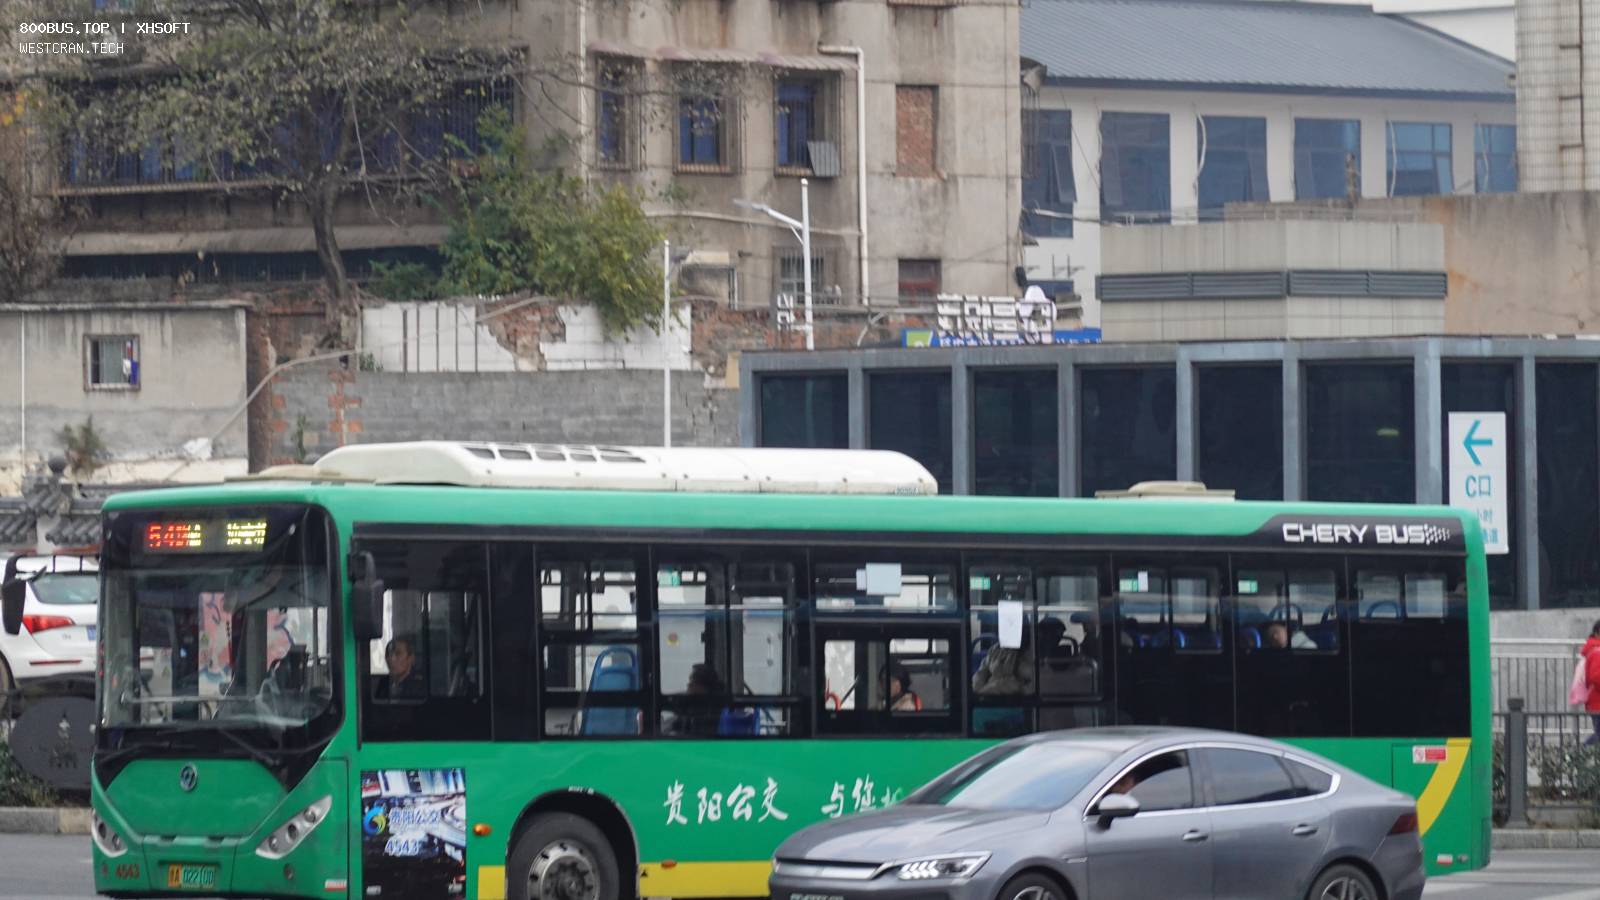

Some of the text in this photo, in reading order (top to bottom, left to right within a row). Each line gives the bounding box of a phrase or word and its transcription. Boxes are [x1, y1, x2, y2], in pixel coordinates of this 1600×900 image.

[1465, 475, 1492, 497] C口
[1282, 523, 1425, 544] CHERY BUS
[663, 776, 789, 825] 贵阳公交
